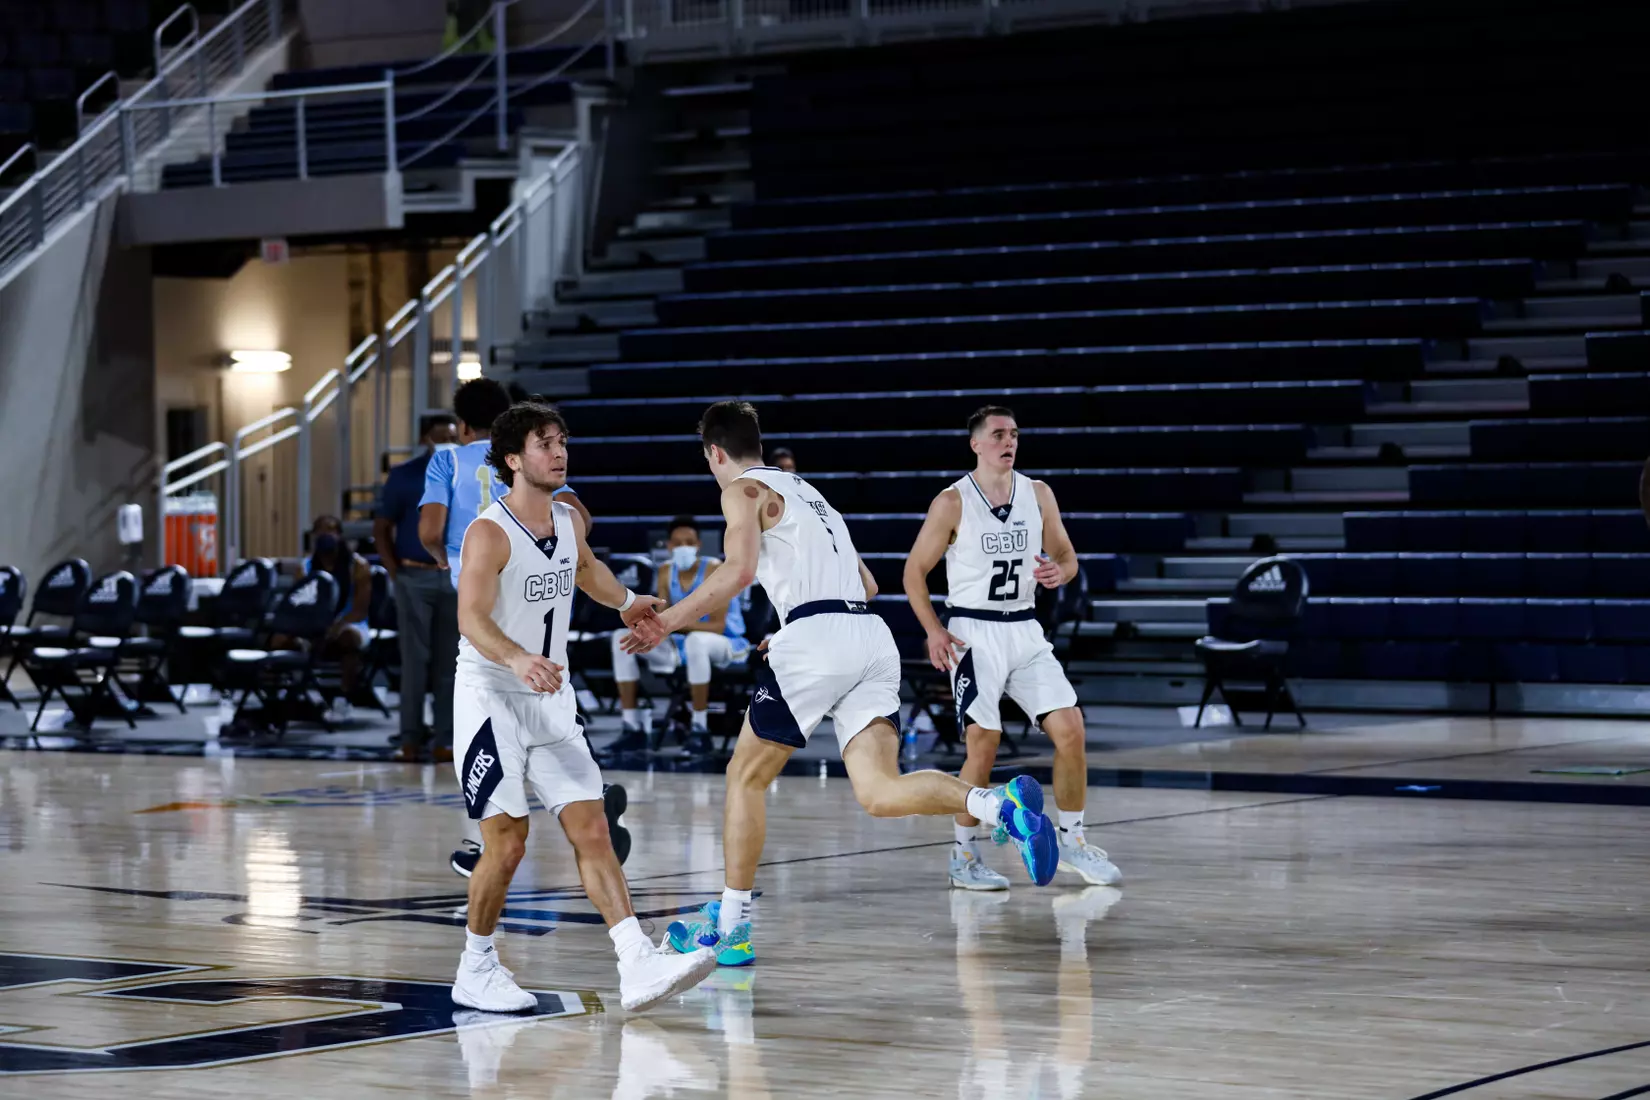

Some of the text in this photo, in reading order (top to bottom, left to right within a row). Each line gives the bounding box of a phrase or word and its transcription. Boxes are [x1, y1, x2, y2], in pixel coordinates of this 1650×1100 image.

[981, 529, 1028, 554] CBU
[524, 568, 573, 602] CBU
[987, 558, 1023, 602] 25
[541, 607, 554, 659] 1
[465, 748, 496, 806] LANCERS
